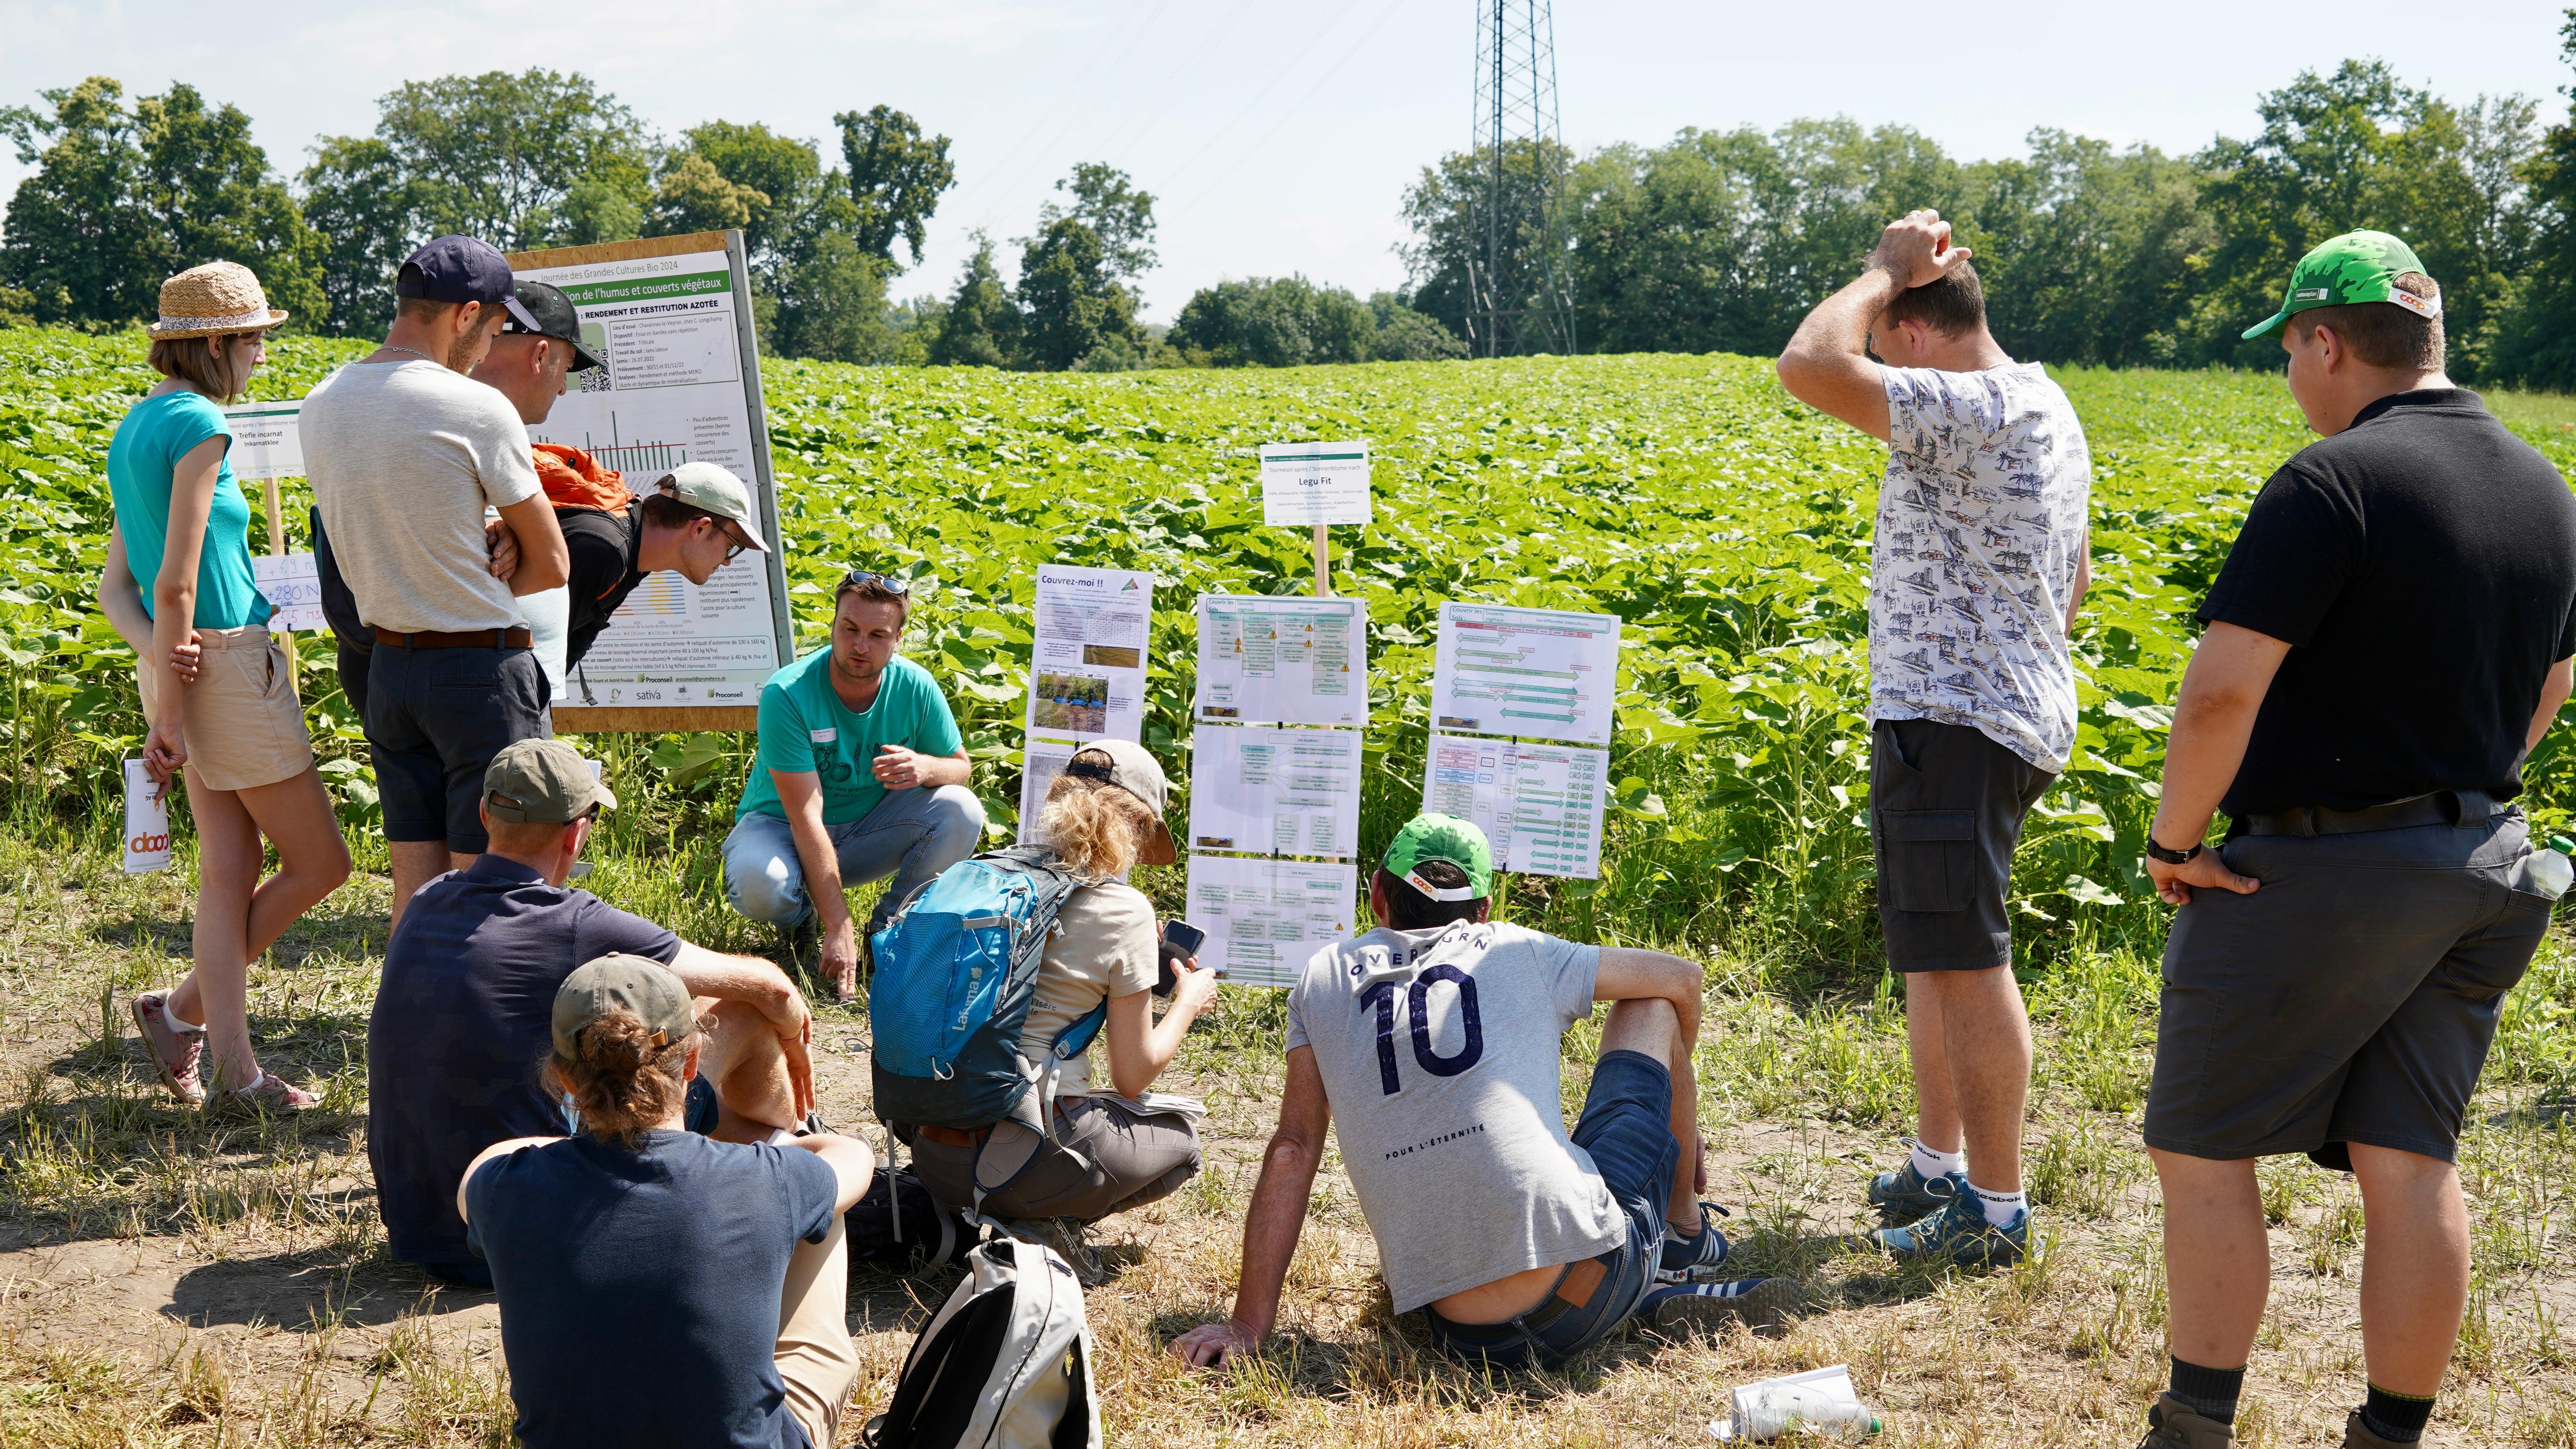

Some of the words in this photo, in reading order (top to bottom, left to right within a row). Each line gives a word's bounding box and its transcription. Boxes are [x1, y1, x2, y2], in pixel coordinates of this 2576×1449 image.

[541, 272, 568, 283] Journée
[570, 271, 583, 279] des
[584, 268, 614, 278] Grandes
[616, 265, 645, 275] Cultures
[647, 264, 659, 272] Bio
[660, 261, 678, 270] 2024
[583, 290, 593, 300] de
[595, 286, 629, 299] l'humus
[632, 286, 640, 296] et
[642, 282, 680, 294] couverts
[681, 278, 721, 292] végétaux
[585, 309, 628, 319] RENDEMENT
[641, 303, 688, 314] RESTITUTION
[690, 299, 718, 309] AZOTÉE
[2399, 293, 2425, 310] coop
[639, 320, 683, 328] Chavannes-le-Veyron,
[1299, 477, 1318, 487] Legu
[1042, 575, 1094, 587] Couvrez-moi
[637, 688, 661, 700] sativa
[131, 831, 169, 853] coop
[1413, 877, 1432, 893] coop
[952, 981, 980, 1031] Lafma
[1360, 964, 1484, 1096] 10
[1385, 1146, 1414, 1160] POUR
[1420, 1123, 1485, 1150] L'ÉTERNITÉ
[1971, 1189, 2021, 1202] Reebok
[1055, 1222, 1076, 1256] SPORTIVA
